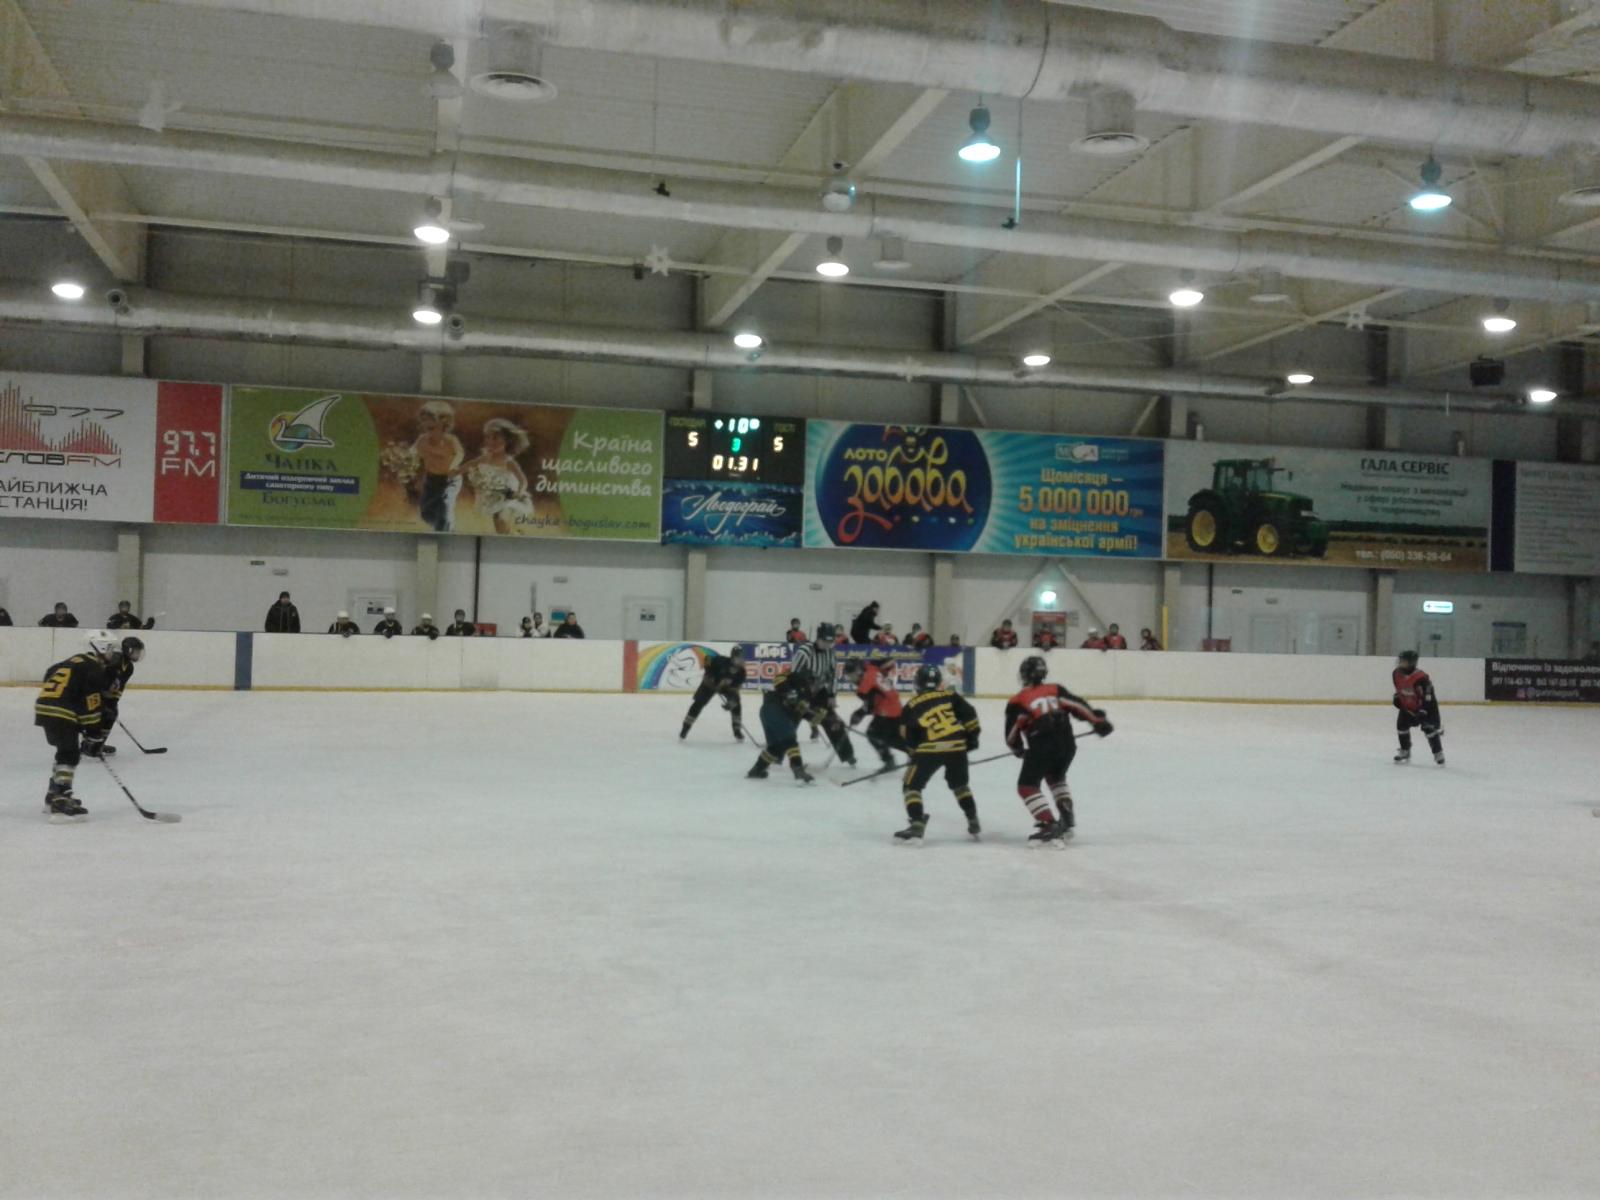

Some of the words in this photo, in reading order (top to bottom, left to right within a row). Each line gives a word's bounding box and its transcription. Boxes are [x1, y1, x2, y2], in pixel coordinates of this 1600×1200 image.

[23, 403, 124, 419] 977
[163, 430, 216, 456] 97.7
[573, 431, 653, 456] Країна
[687, 431, 698, 447] 5
[773, 436, 784, 452] 5
[844, 447, 888, 462] ЛОТО
[161, 457, 216, 478] FM
[542, 456, 653, 475] щасливого
[1360, 458, 1398, 472] ГАЛА
[1401, 460, 1450, 475] СЕРВІС
[535, 475, 653, 497] дитинства
[1019, 485, 1033, 512] 5
[1039, 487, 1082, 513] 000
[1086, 489, 1129, 516] 000
